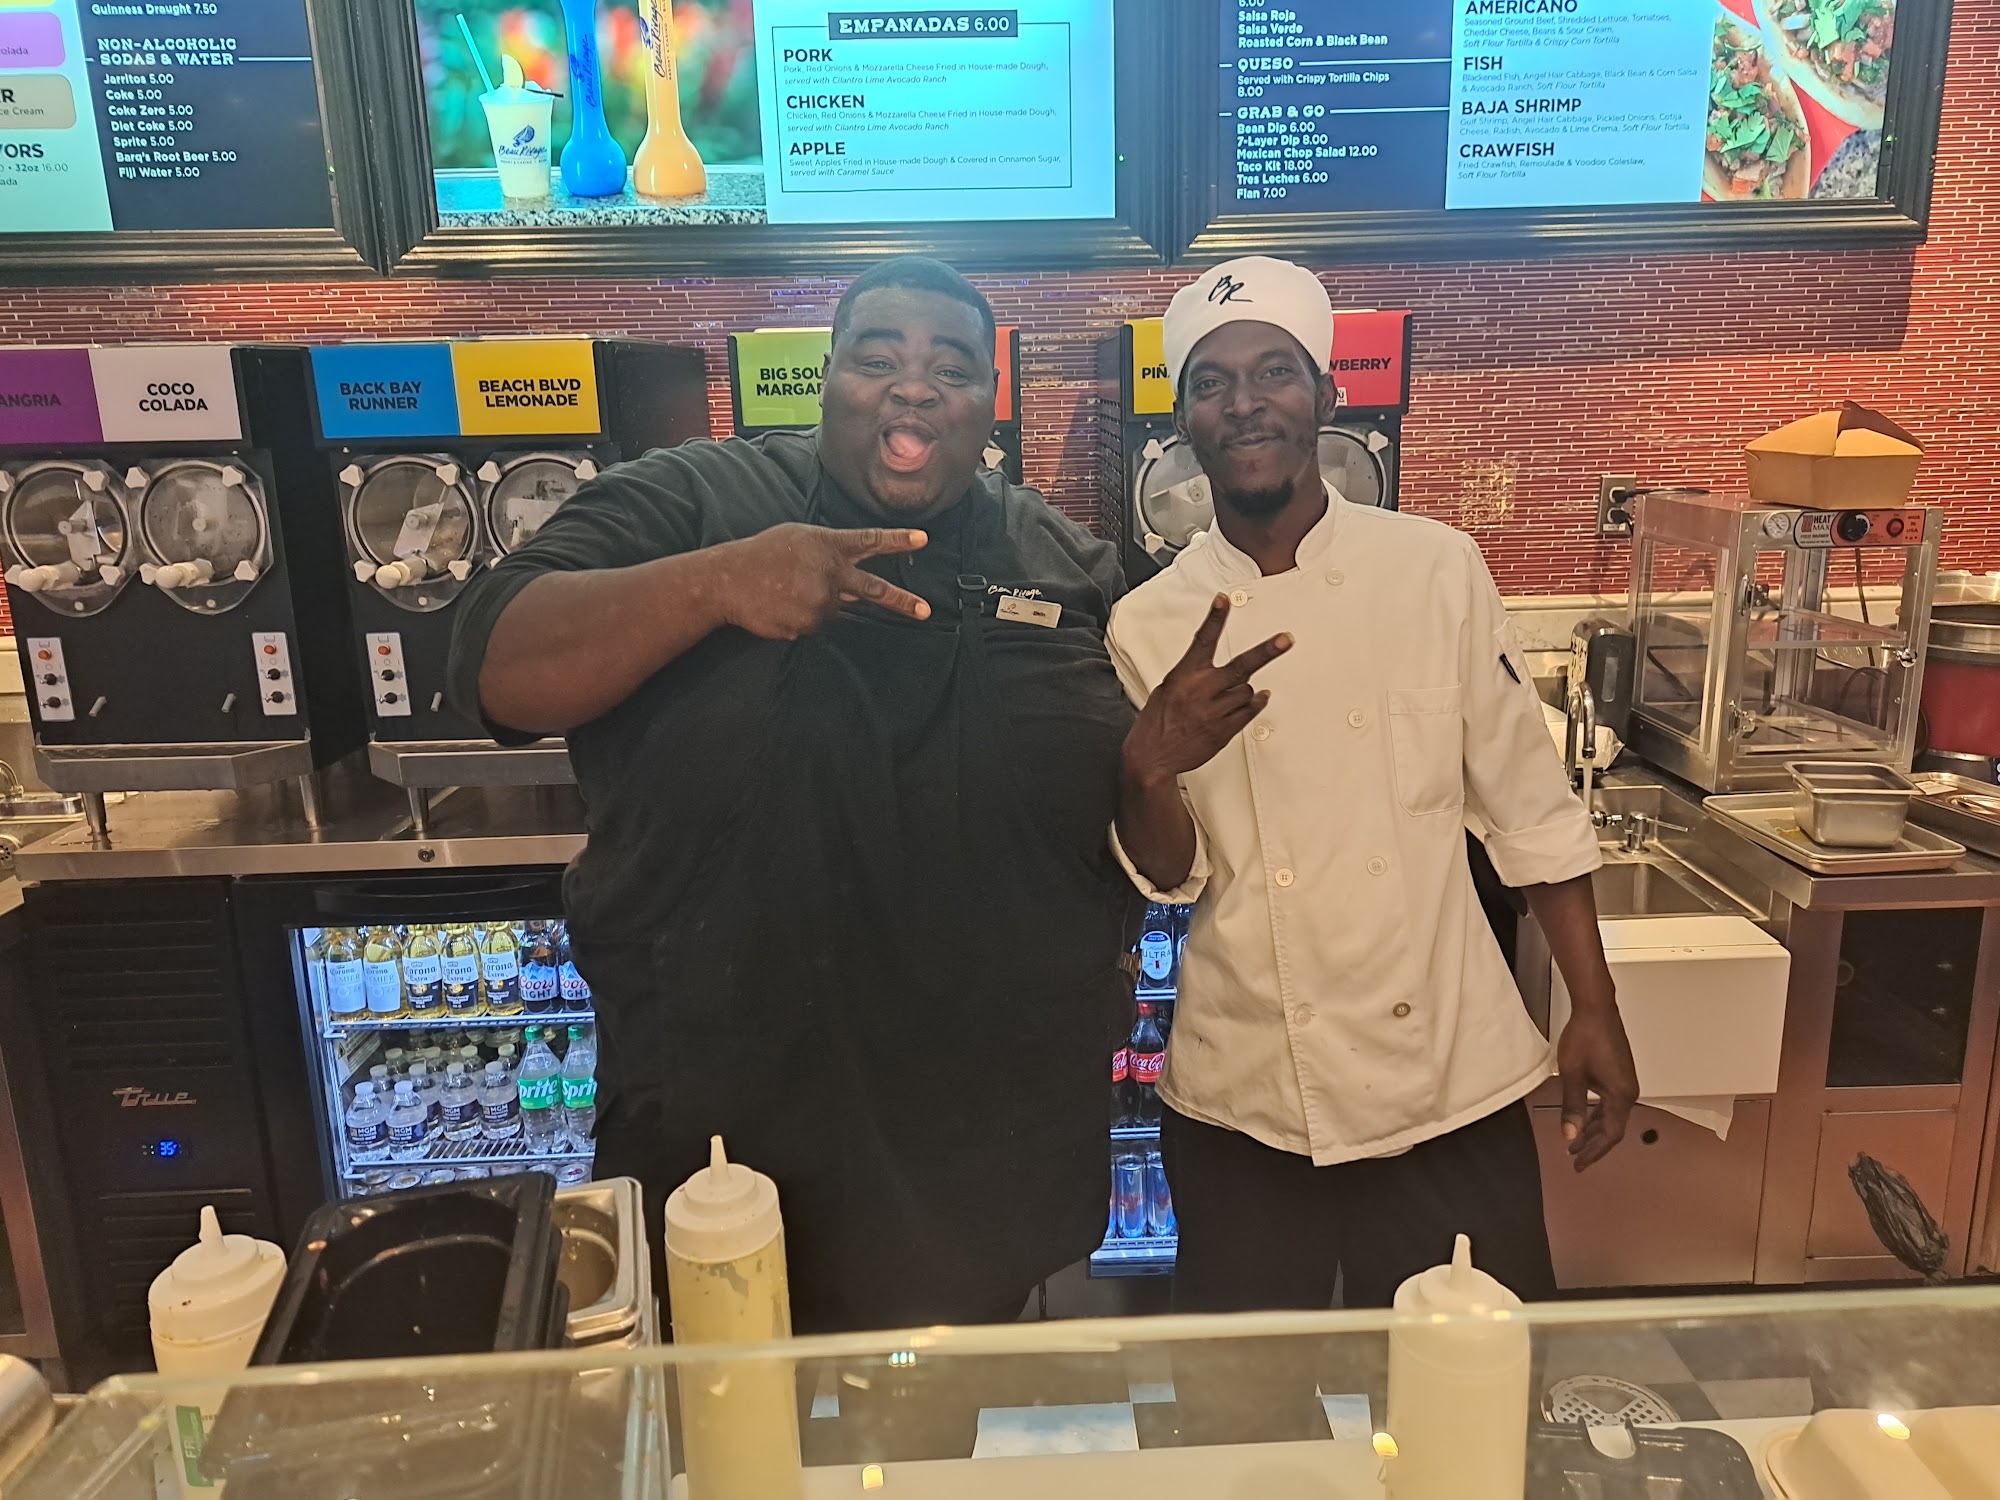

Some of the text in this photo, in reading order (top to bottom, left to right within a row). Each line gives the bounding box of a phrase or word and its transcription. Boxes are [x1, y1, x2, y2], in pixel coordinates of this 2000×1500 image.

[91, 3, 217, 16] Guinness Draught 7.50
[1465, 0, 1577, 14] AMERICANO
[1238, 10, 1295, 22] Salsa Roja
[839, 17, 1009, 33] EMPANADAS 6.00
[1238, 23, 1303, 35] Salsa Verde
[97, 38, 236, 50] NON-ALCOHOLIC
[1238, 34, 1388, 48] Roasted Corn & Black Bean
[100, 53, 234, 65] SODAS & WATER
[784, 49, 832, 62] PORK
[784, 65, 804, 73] Pork,
[806, 64, 822, 72] Red
[824, 64, 852, 72] Onions
[906, 63, 933, 71] Cheese
[968, 62, 1017, 70] House-made
[1020, 62, 1048, 71] Dough,
[1238, 57, 1293, 72] QUESO
[1464, 56, 1503, 70] FISH
[103, 74, 174, 85] Jarritos 5.00
[813, 76, 830, 84] with
[832, 76, 863, 84] Cilantro
[887, 75, 921, 83] Avocado
[923, 75, 946, 83] Ranch
[1238, 72, 1390, 85] Served with Crispy Tortilla Chips
[105, 89, 162, 100] Coke 5.00
[1237, 86, 1263, 97] 8.00
[786, 95, 864, 108] CHICKEN
[1462, 98, 1581, 115] BAJA SHRIMP
[12, 107, 44, 115] Cream
[108, 105, 193, 116] Coke Zero 5.00
[1237, 105, 1325, 119] GRAB & GO
[111, 120, 193, 131] Diet Coke 5.00
[1237, 122, 1315, 134] Bean Dip 6.00
[113, 136, 175, 148] Sprite 5.00
[1237, 134, 1328, 147] 7-Layer Dip 8.00
[790, 142, 845, 155] APPLE
[1236, 145, 1377, 159] Mexican Chop Salad 12.00
[1460, 142, 1554, 157] CRAWFISH
[116, 151, 236, 163] Barq's Root Beer 5.00
[1458, 161, 1478, 169] Fried
[1481, 160, 1517, 168] Crawfish,
[1520, 159, 1565, 168] Remoulade
[1608, 158, 1645, 166] Coleslaw,
[15, 163, 39, 172] 32oz
[42, 163, 68, 171] 16.00
[1237, 160, 1313, 172] Taco Kit 18.00
[119, 167, 200, 179] Fiji Water 5.00
[1237, 172, 1328, 185] Tres Leches 6.00
[1476, 171, 1497, 179] Flour
[1236, 187, 1286, 199] Flan 7.00
[1208, 274, 1253, 305] BR
[1142, 363, 1170, 379] PIÑ
[1330, 358, 1391, 371] WBERRY
[760, 367, 823, 380] BIG SOU
[147, 383, 194, 396] COCO
[339, 381, 422, 395] BACK BAY
[478, 379, 581, 392] BEACH BLVD
[756, 382, 822, 396] MARGA
[0, 393, 62, 407] ANGRIA
[139, 398, 208, 411] COLADA
[349, 396, 418, 410] RUNNER
[485, 394, 578, 407] LEMONADE
[1814, 515, 1831, 524] HEAT
[1143, 950, 1170, 958] ULTRA
[404, 966, 436, 975] Corona
[441, 966, 473, 976] Corona
[484, 962, 513, 970] Corona
[520, 975, 554, 989] Coors
[519, 1079, 557, 1099] prite
[112, 1086, 196, 1106] True
[444, 1107, 460, 1115] MGM
[490, 1104, 507, 1113] MGM
[358, 1126, 376, 1134] MGM
[394, 1126, 412, 1135] MGM
